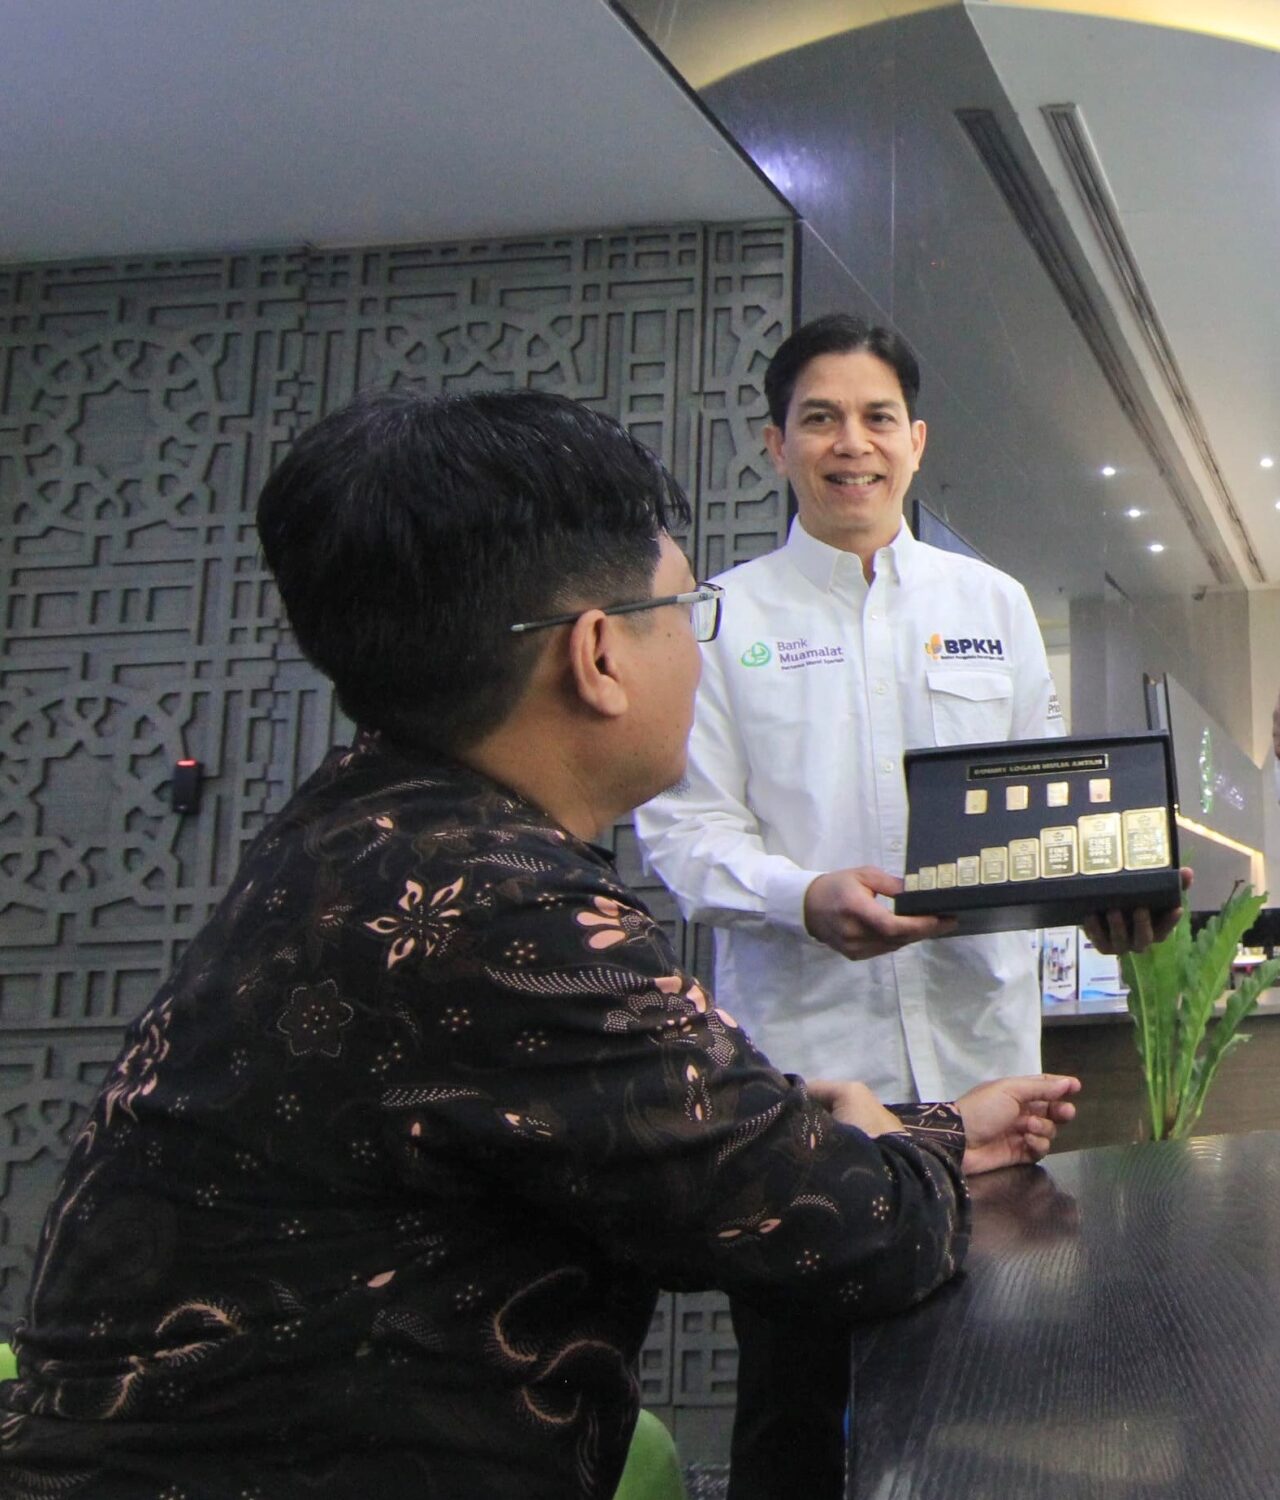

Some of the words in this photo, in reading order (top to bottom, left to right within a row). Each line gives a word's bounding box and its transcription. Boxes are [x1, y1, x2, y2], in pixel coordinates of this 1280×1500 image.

[777, 638, 808, 651] Bank
[944, 638, 1003, 655] BPKH
[779, 646, 843, 663] Muamalat
